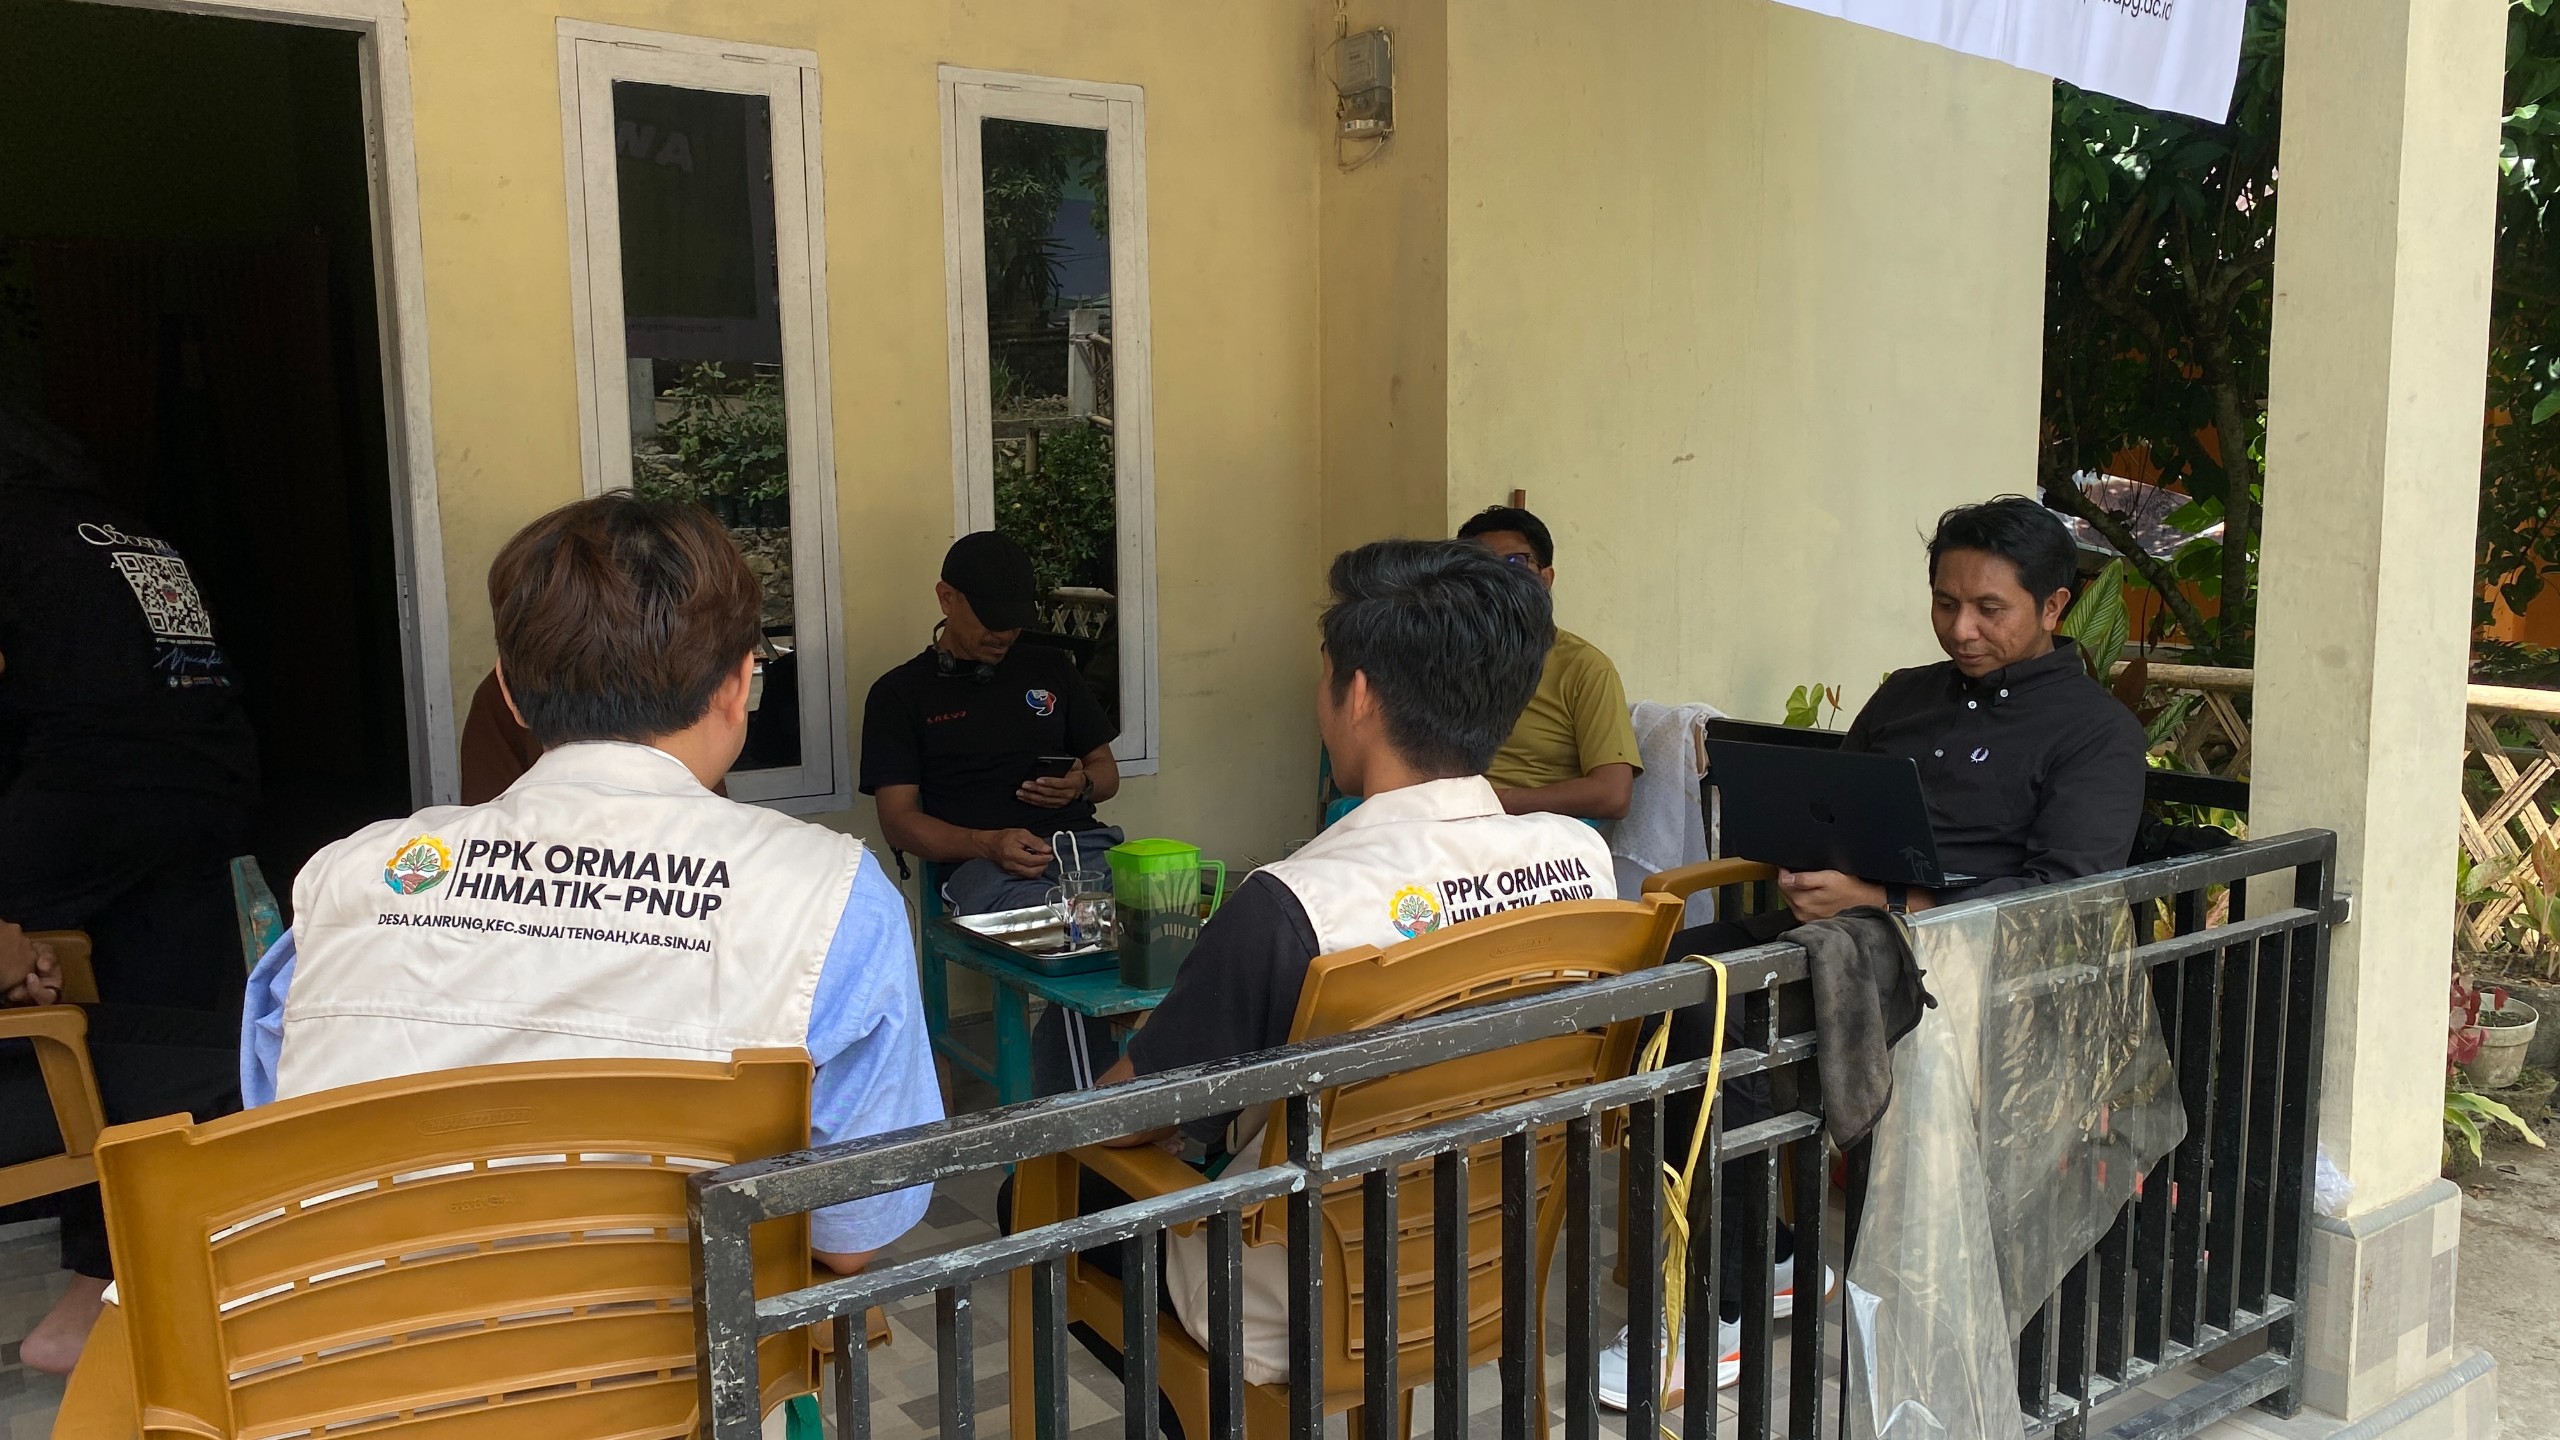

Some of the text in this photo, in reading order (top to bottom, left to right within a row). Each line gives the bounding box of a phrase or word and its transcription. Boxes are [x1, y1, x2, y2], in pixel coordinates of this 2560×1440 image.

[464, 839, 731, 889] PPK ORMAWA
[1443, 857, 1591, 906] PPK ORMAWA
[377, 913, 409, 926] DESA
[455, 872, 722, 921] HIMATIK-PNUP
